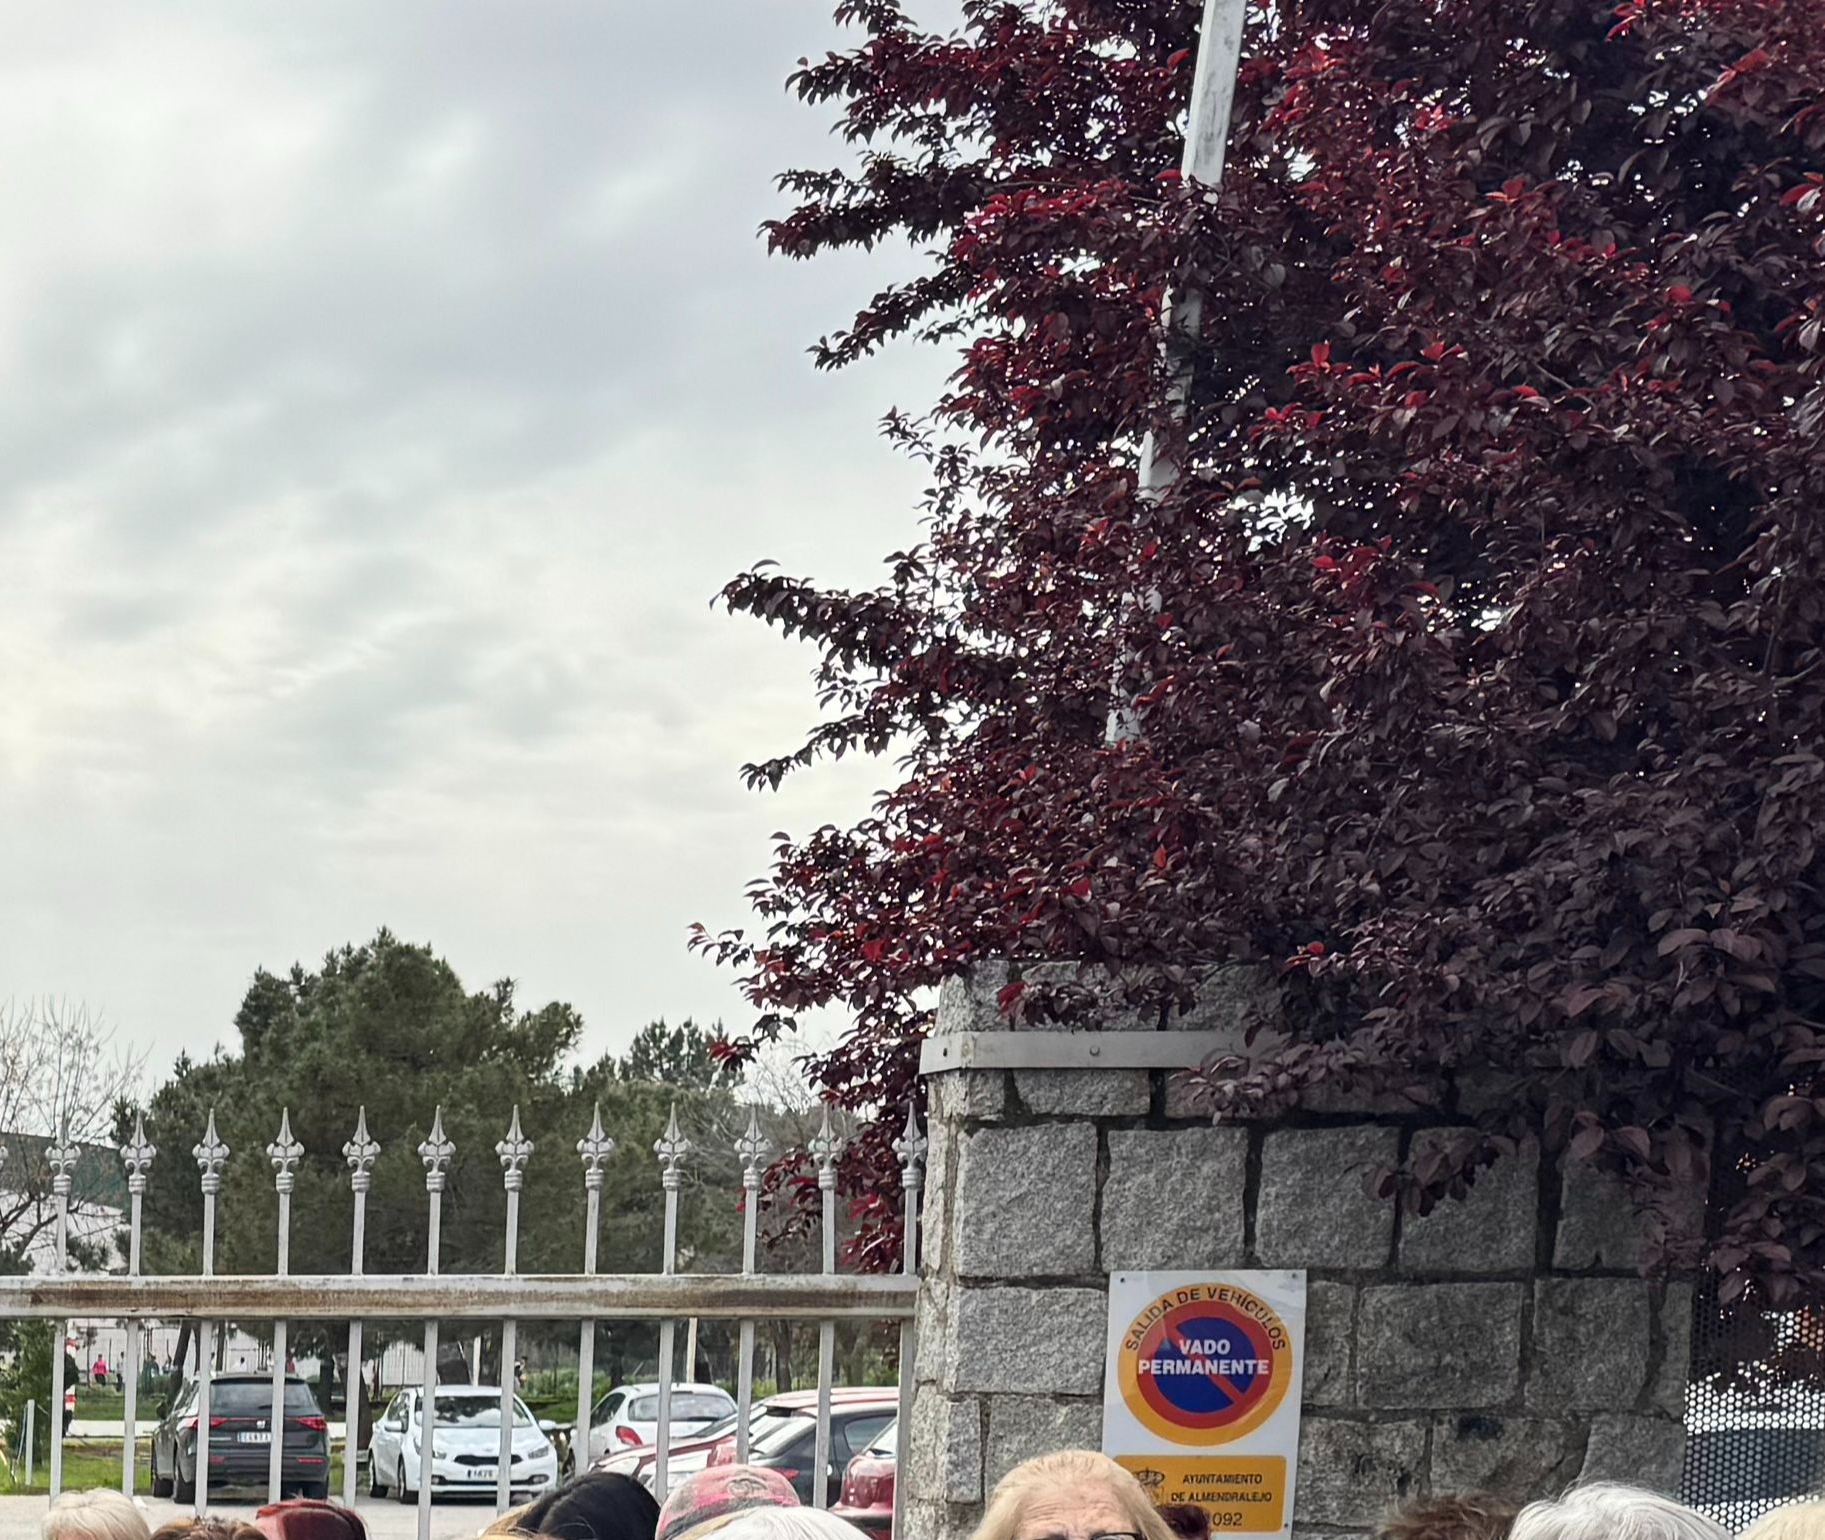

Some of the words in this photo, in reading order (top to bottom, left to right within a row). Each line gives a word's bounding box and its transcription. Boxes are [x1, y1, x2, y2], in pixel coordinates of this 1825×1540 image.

[1125, 1300, 1174, 1351] SALIDA
[1176, 1287, 1202, 1304] DE
[1178, 1339, 1231, 1356] VADO
[1138, 1359, 1270, 1376] PERMANENTE
[1182, 1474, 1263, 1485] AYUNTAMIENTO
[1171, 1492, 1186, 1502] DE
[1188, 1491, 1272, 1503] ALMENDRALEJO
